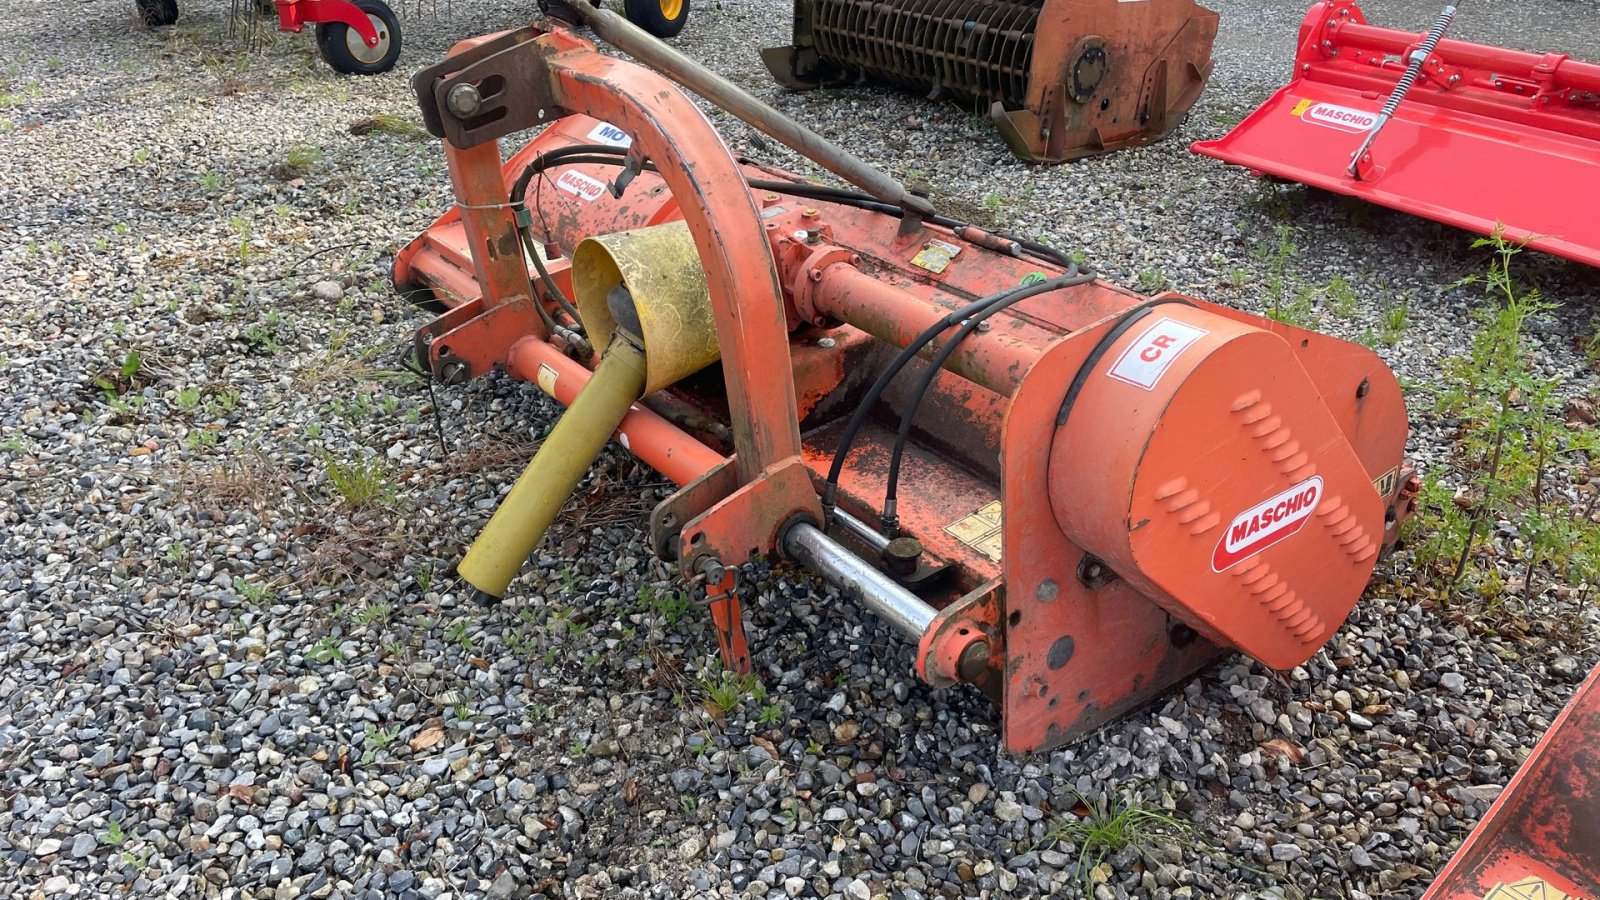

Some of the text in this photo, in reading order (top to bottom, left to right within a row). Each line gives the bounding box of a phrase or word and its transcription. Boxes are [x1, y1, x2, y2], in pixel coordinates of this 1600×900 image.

[1315, 107, 1372, 126] MASCHIO
[560, 173, 602, 196] MASCHIO
[1140, 335, 1177, 362] CR
[1230, 486, 1317, 546] MASCHIO
